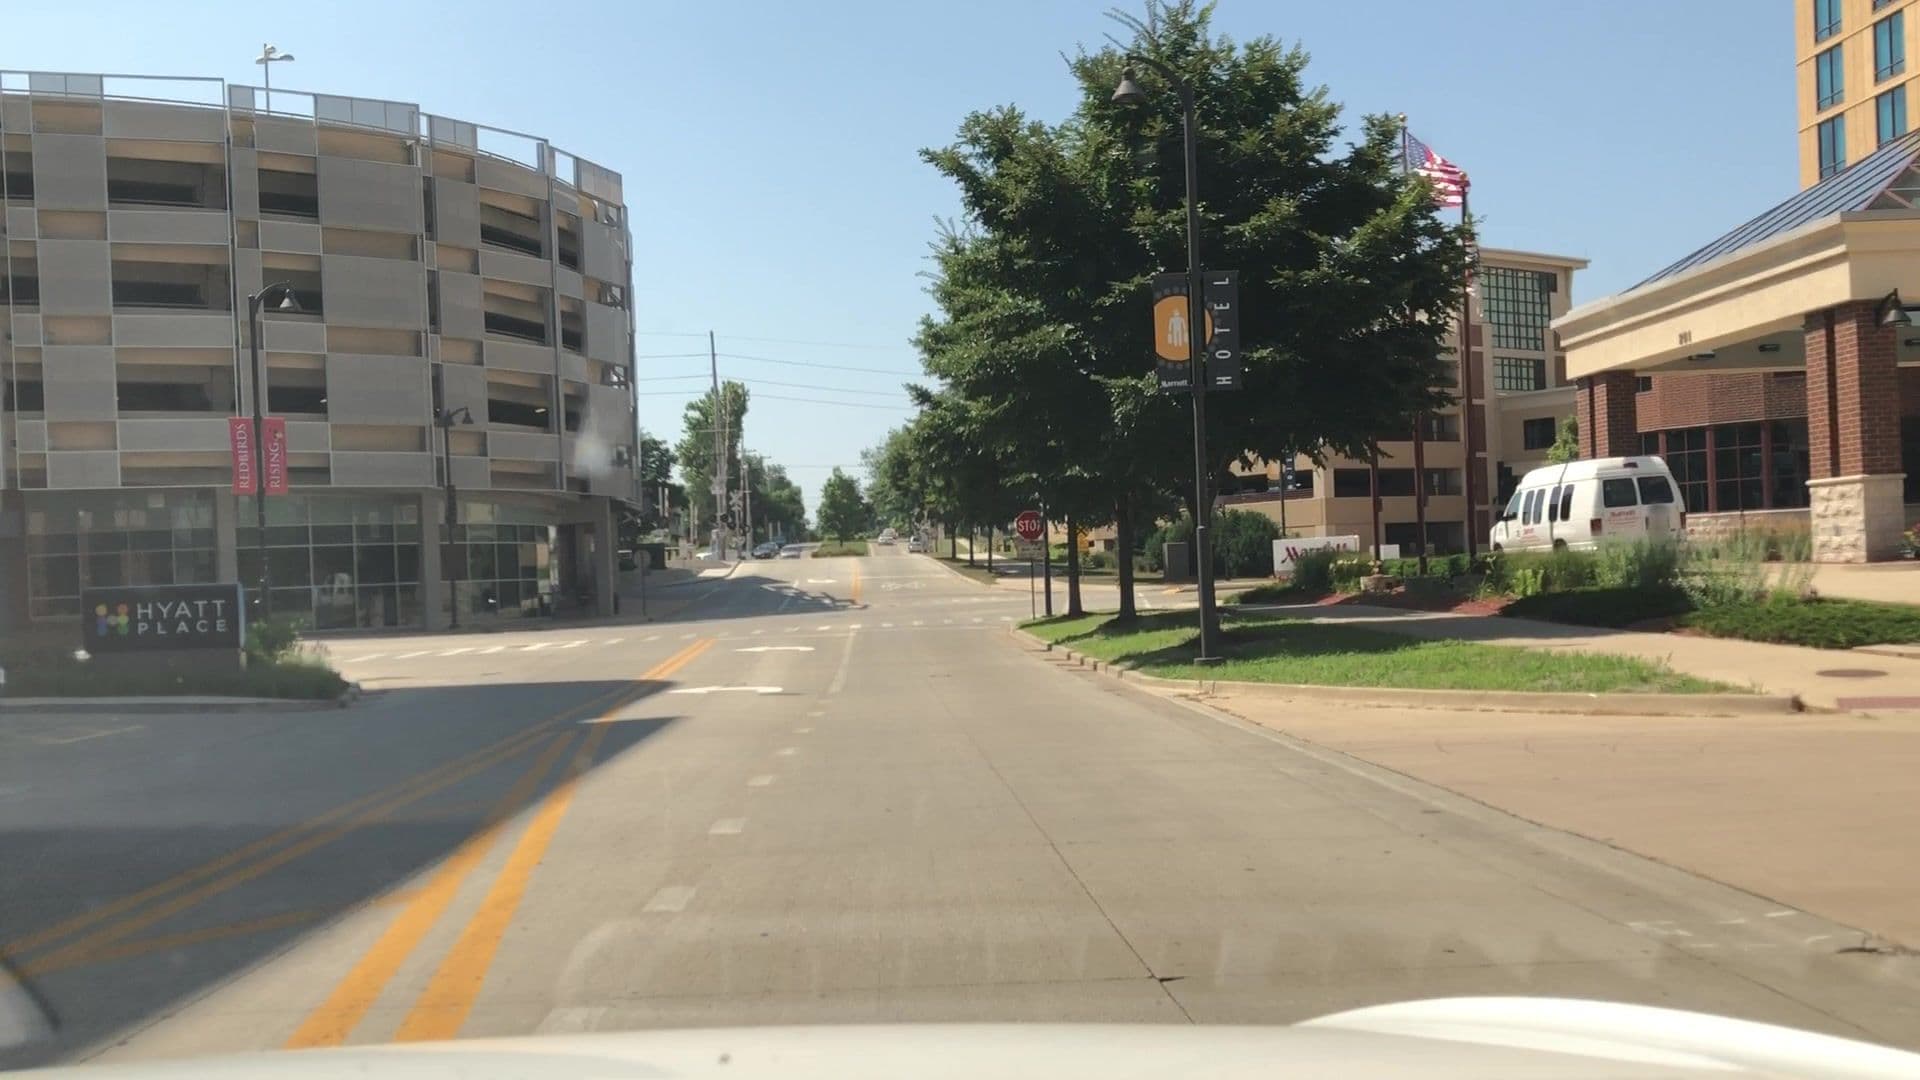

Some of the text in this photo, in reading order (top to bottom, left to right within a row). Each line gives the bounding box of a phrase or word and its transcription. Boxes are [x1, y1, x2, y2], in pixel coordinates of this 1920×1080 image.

[1213, 277, 1232, 385] HOTEL
[235, 423, 249, 489] REDBIRDS
[269, 442, 281, 488] RISING
[1281, 541, 1347, 564] Matt
[137, 600, 226, 620] HYATT
[137, 619, 227, 635] PLACE
